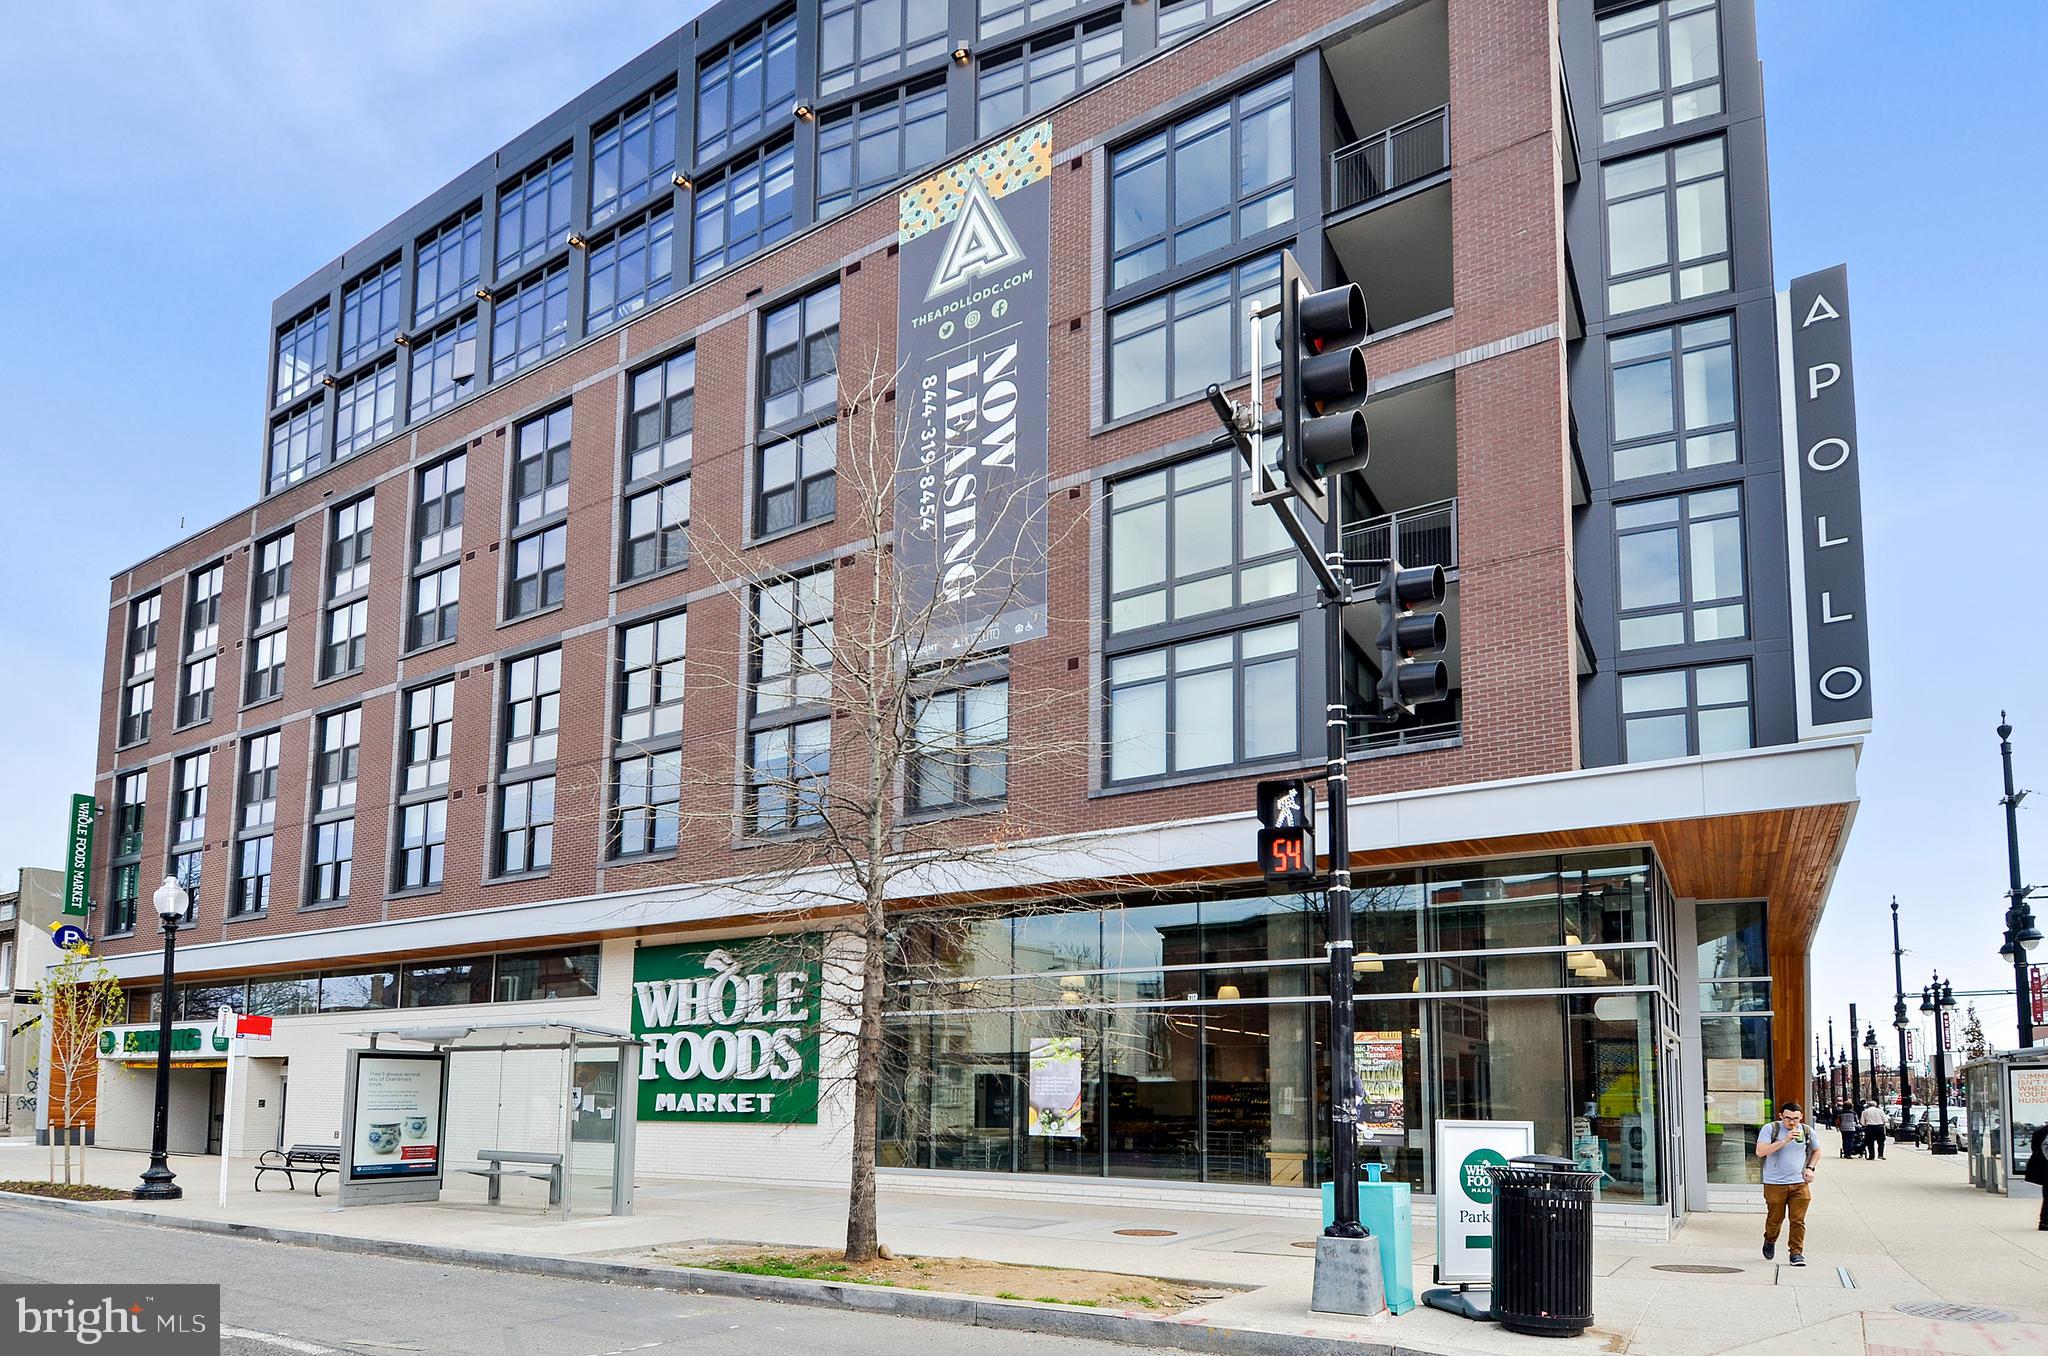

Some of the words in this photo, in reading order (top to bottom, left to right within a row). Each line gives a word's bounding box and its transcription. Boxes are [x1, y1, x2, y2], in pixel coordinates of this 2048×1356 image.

[923, 173, 1026, 303] A
[911, 269, 1033, 329] THEAPOLLODC.COM
[981, 339, 1018, 472] NOW
[919, 374, 938, 531] 844-319-8454
[943, 354, 978, 603] LEASING
[1802, 294, 1863, 700] APOLLO
[77, 802, 93, 835] WHOLE
[74, 837, 87, 869] FOODS
[1273, 838, 1301, 872] 54
[71, 870, 85, 908] MARKET
[63, 930, 79, 945] P
[634, 958, 809, 1028] WHOLE
[639, 1028, 803, 1081] FOODS
[655, 1093, 776, 1113] MARKET
